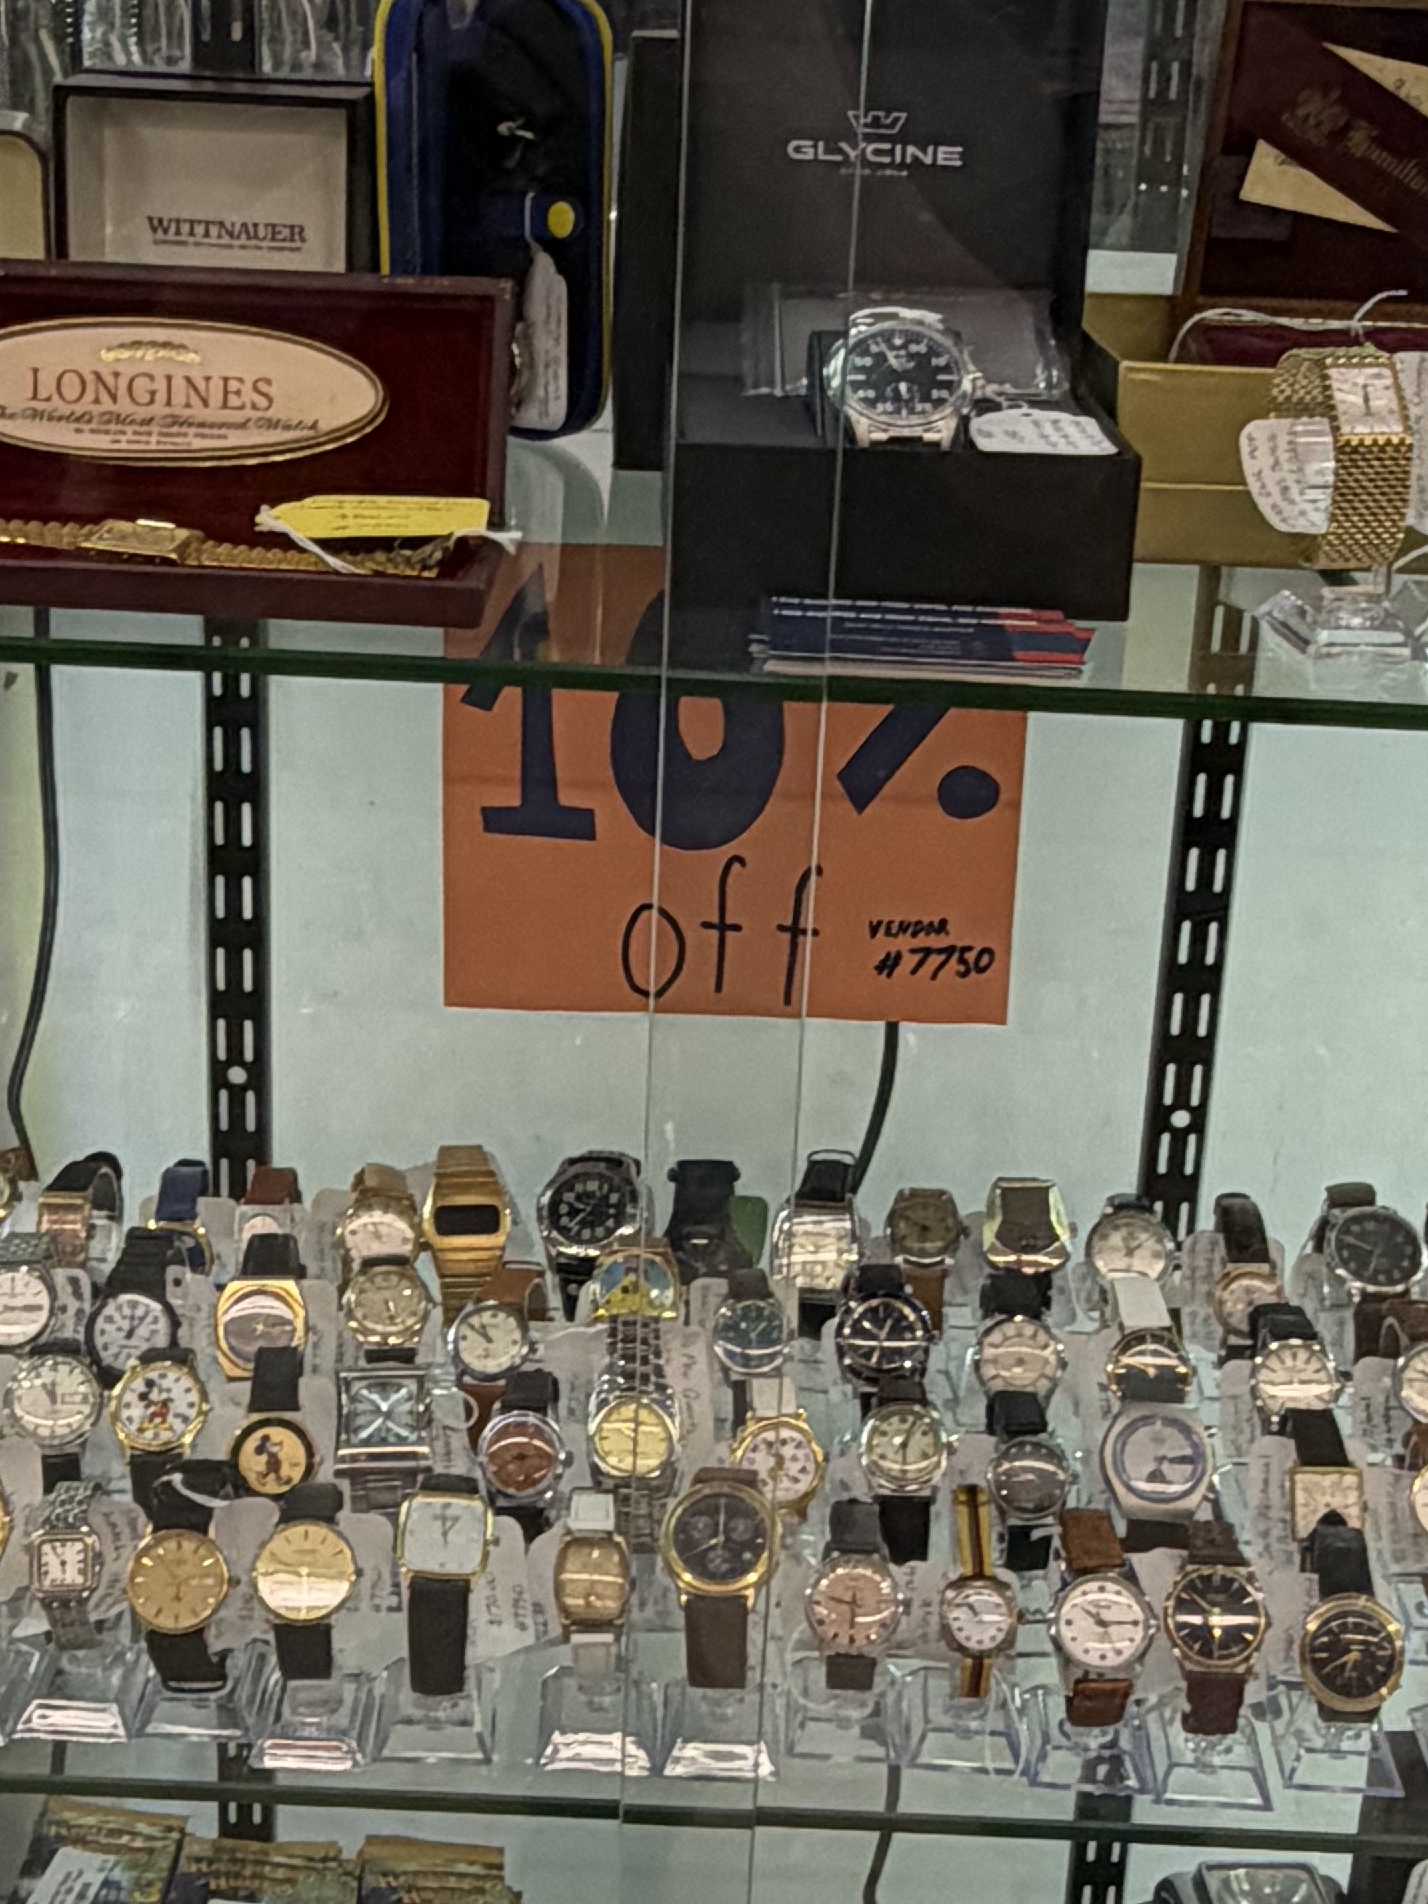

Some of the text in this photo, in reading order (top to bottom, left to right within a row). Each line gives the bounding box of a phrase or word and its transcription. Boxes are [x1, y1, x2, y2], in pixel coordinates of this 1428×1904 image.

[786, 139, 964, 168] GLYCINE
[146, 214, 307, 244] WITTNAUER
[29, 366, 275, 412] LONGINES
[874, 944, 995, 979] #7750
